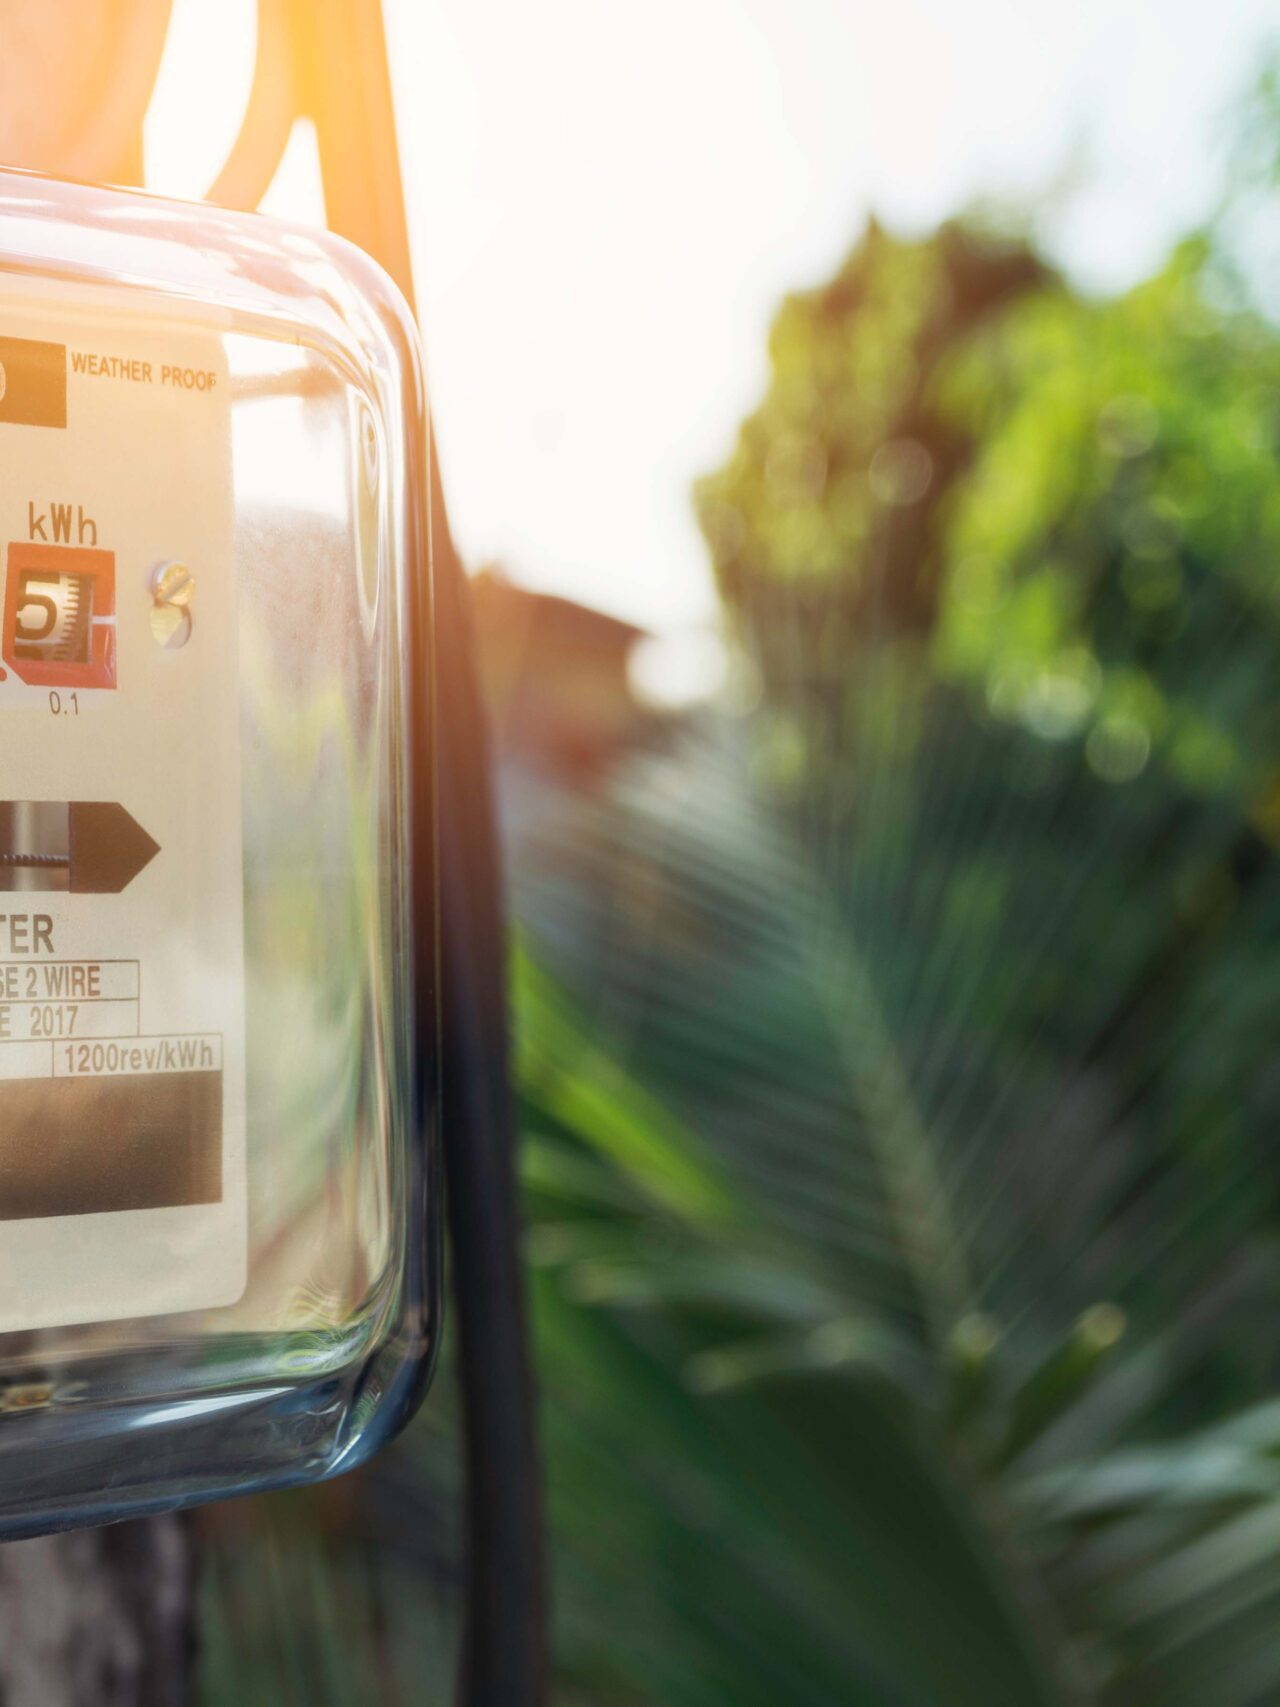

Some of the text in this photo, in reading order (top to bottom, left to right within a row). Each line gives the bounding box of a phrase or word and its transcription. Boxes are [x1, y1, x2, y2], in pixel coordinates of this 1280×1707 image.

[71, 351, 216, 392] WEATHER PROOF
[29, 501, 97, 546] kWh
[49, 692, 80, 716] 0.1
[25, 967, 37, 998] 2
[45, 965, 101, 997] WIRE
[30, 1005, 79, 1037] 2017
[64, 1039, 214, 1073] 1200rev/kWh
